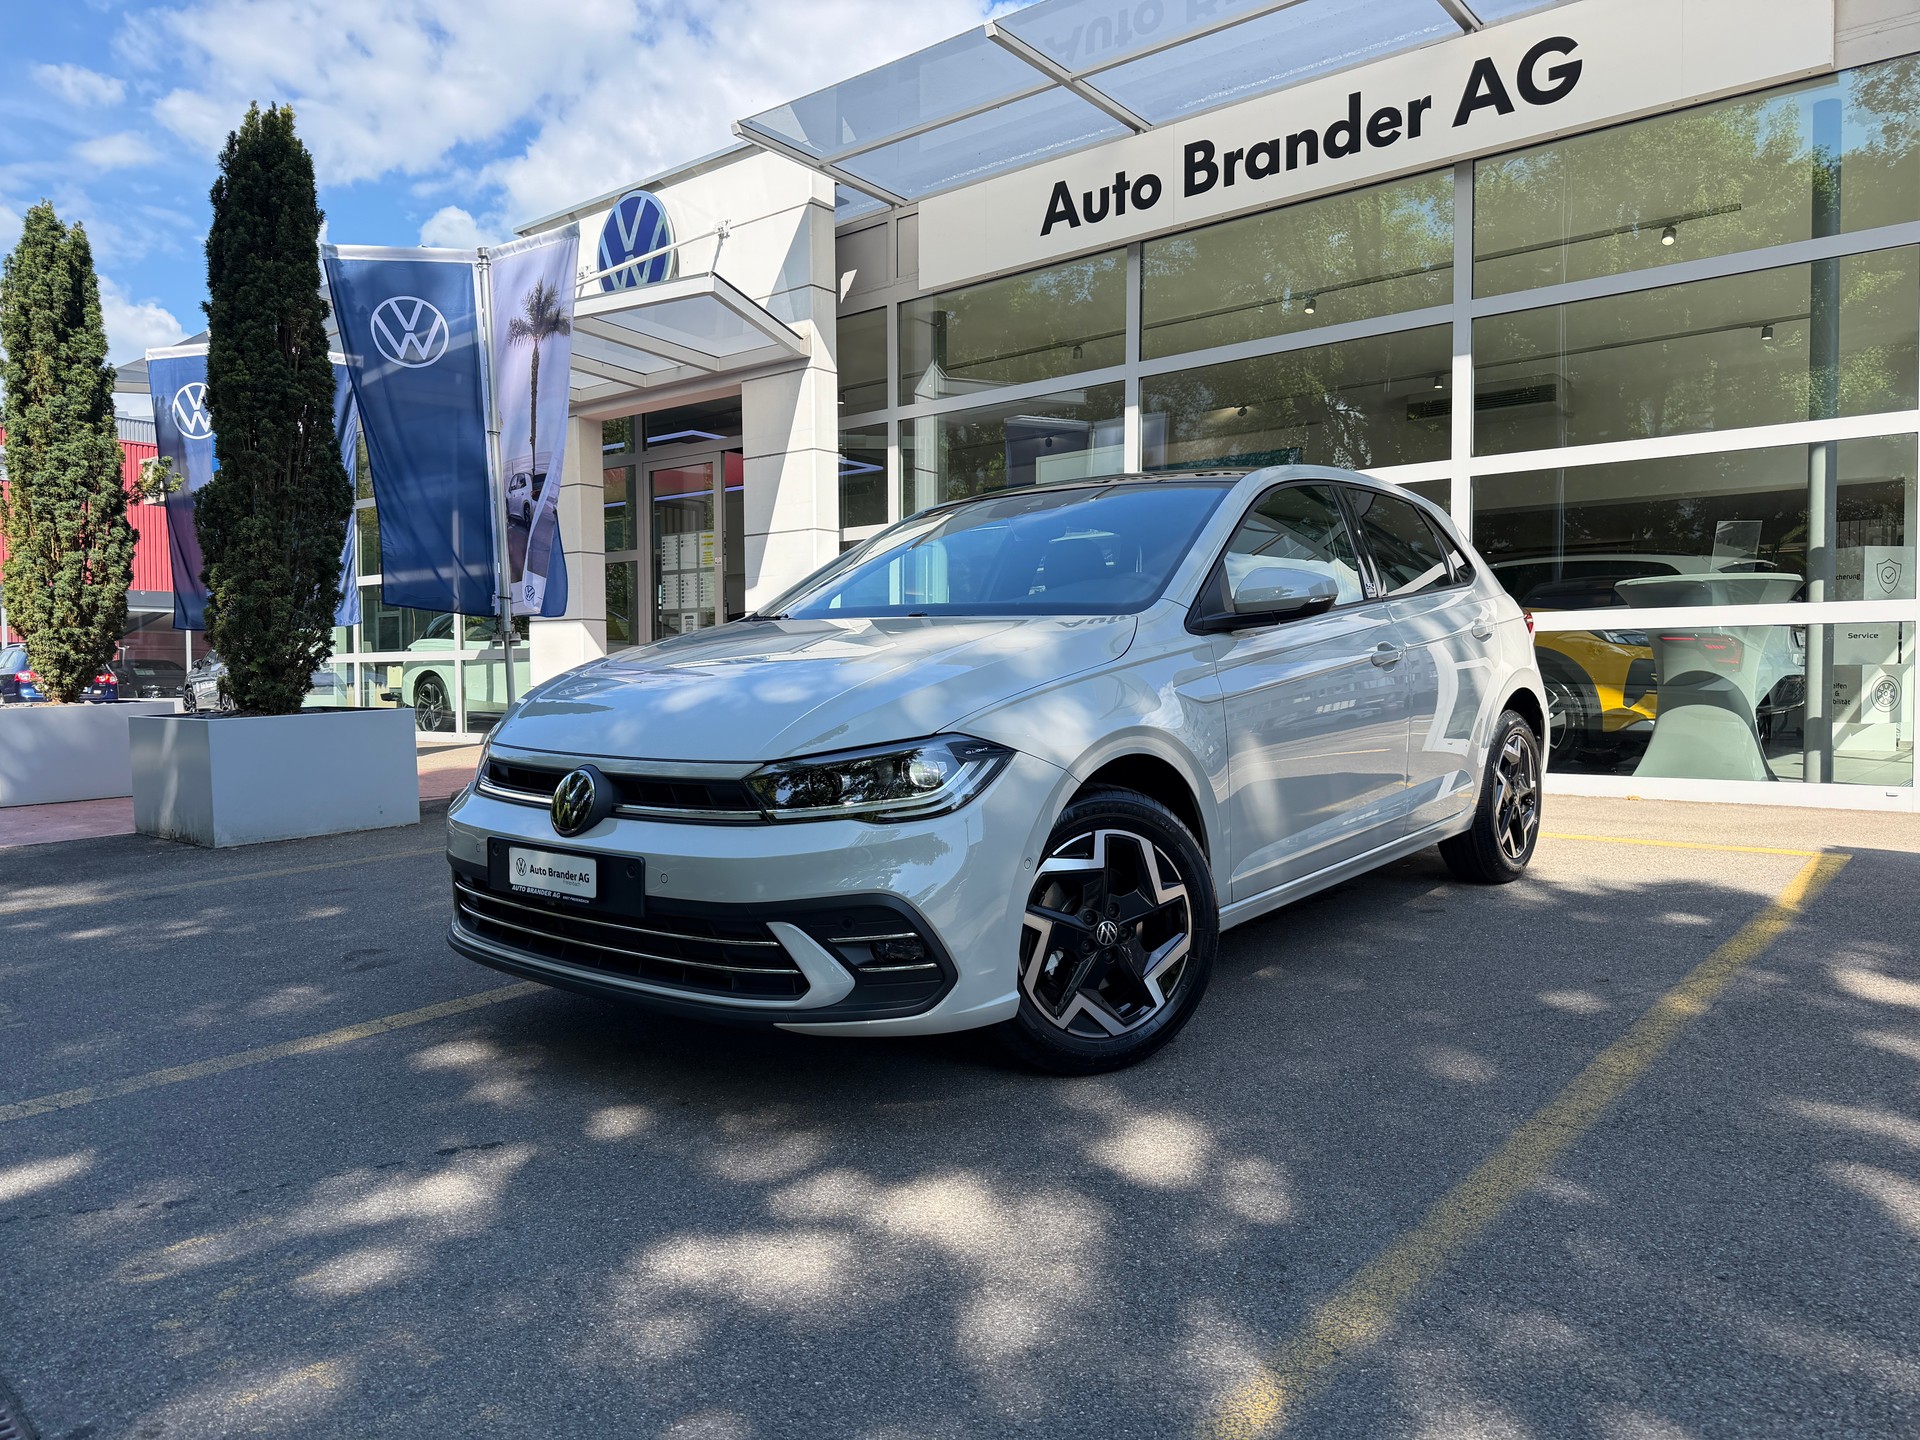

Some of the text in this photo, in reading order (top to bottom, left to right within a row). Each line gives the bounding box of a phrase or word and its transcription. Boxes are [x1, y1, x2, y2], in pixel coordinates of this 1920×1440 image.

[1040, 35, 1584, 237] Auto Brander AG
[370, 295, 450, 369] VW
[526, 887, 552, 897] BRANDER
[529, 864, 590, 884] Auto Brander AG
